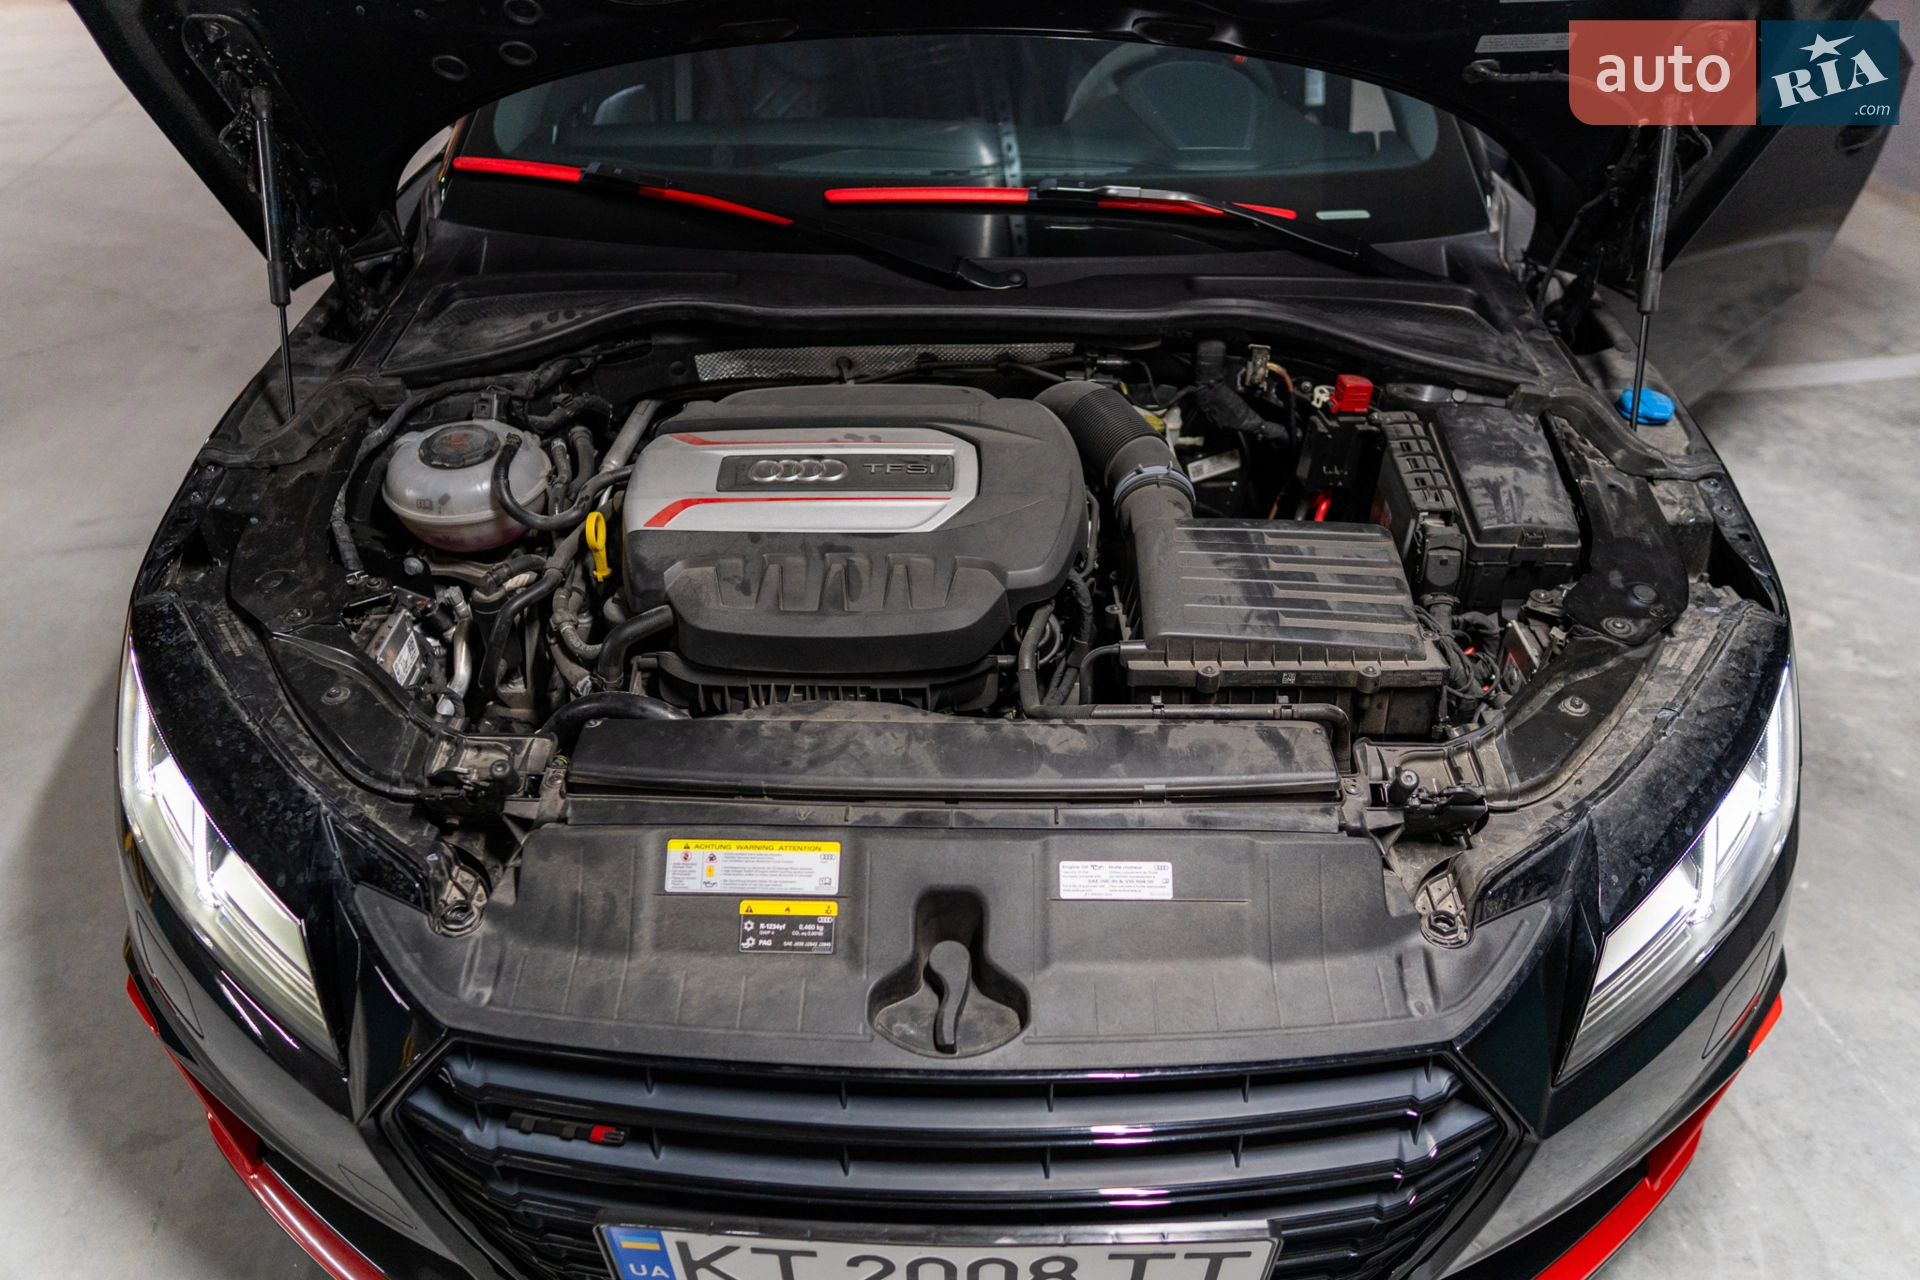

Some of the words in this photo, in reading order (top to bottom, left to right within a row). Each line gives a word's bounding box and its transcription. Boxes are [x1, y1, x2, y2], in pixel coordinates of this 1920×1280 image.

[863, 463, 936, 475] TFSI
[759, 923, 786, 931] R-1234yf
[816, 924, 824, 932] kg
[675, 1241, 818, 1280] KT
[629, 1262, 670, 1279] UA
